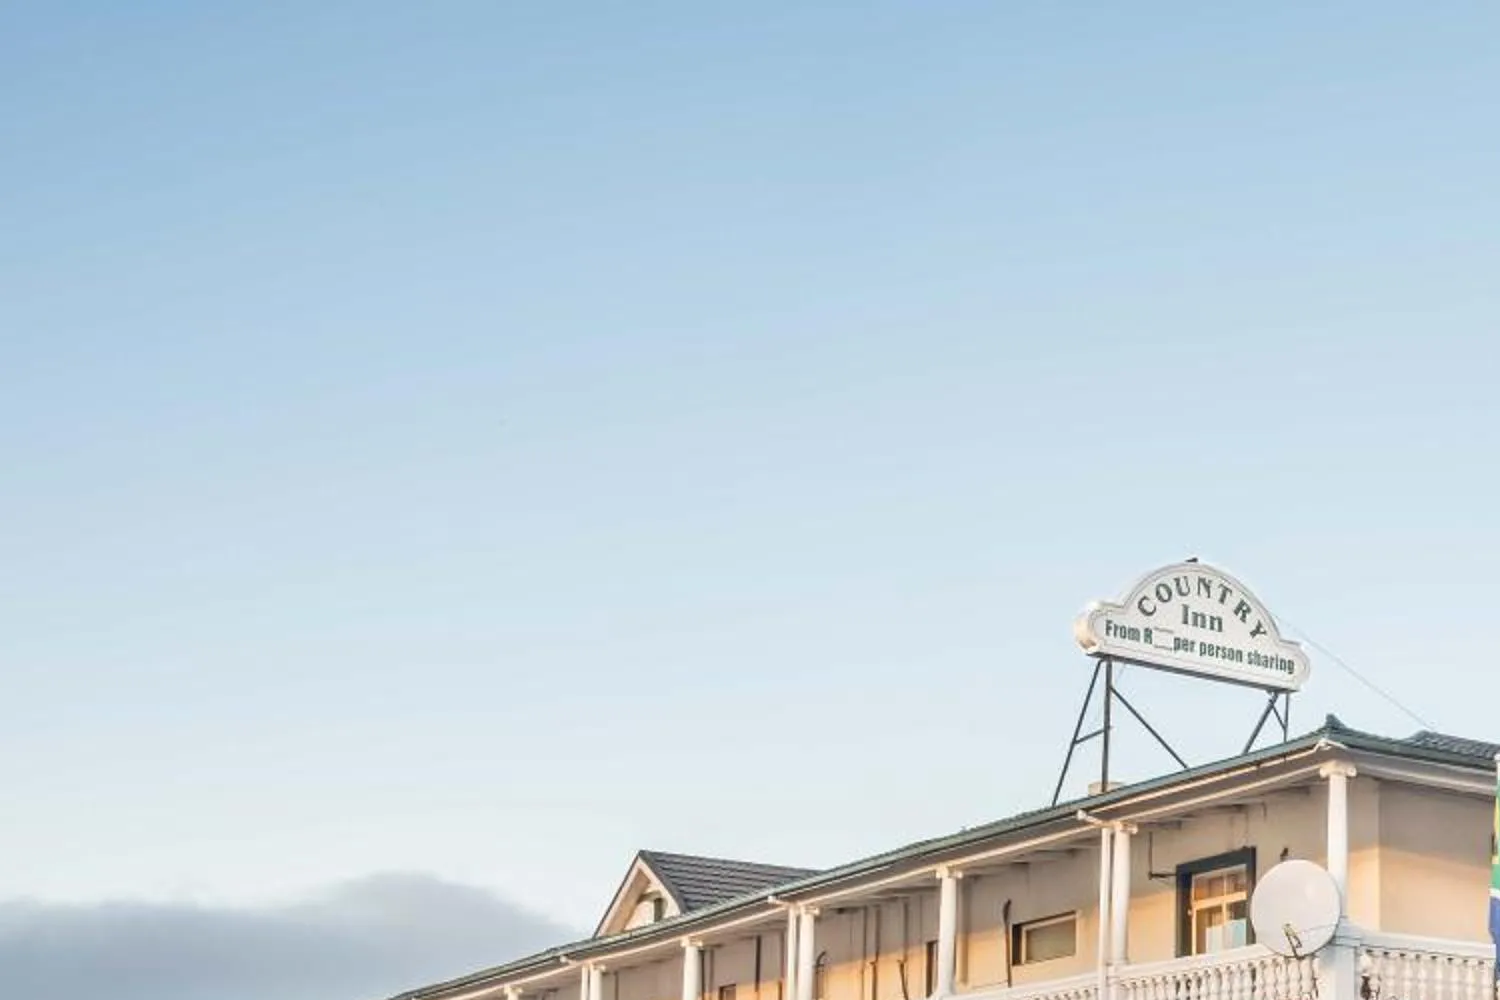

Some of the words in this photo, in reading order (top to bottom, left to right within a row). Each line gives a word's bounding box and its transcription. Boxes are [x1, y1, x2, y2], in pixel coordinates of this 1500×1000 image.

[1137, 575, 1268, 638] COUNTRY
[1181, 603, 1223, 633] Inn
[1105, 619, 1141, 643] From
[1173, 636, 1196, 653] per
[1199, 641, 1243, 663] person
[1247, 649, 1295, 675] sharing
